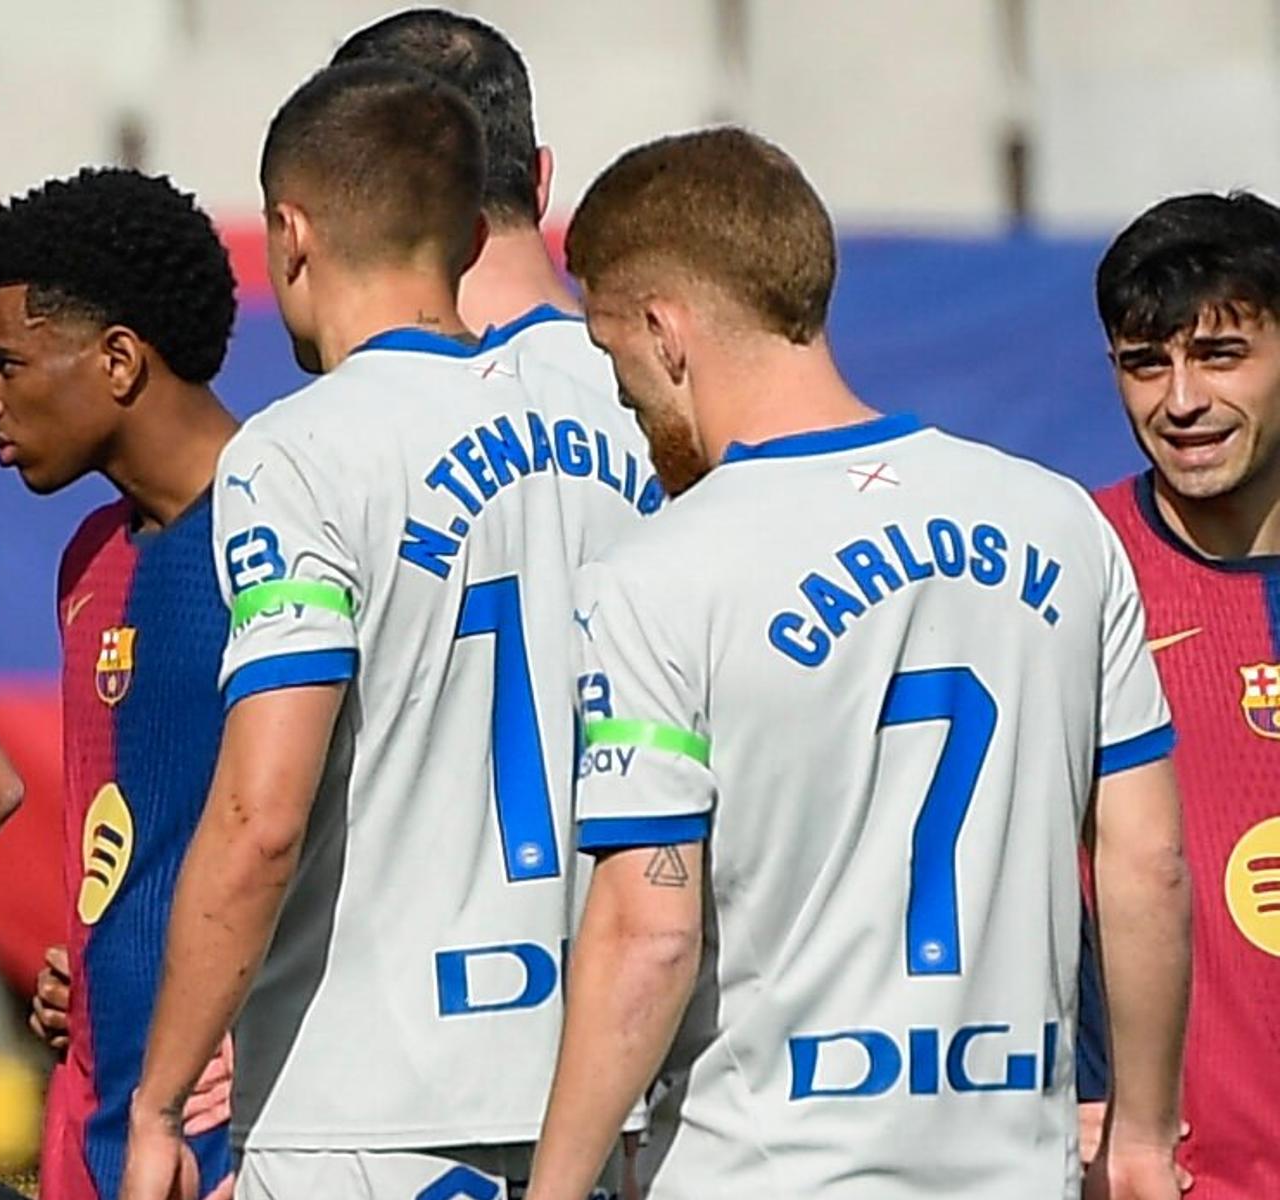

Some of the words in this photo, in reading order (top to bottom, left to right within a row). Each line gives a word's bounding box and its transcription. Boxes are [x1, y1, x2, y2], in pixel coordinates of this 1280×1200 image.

[769, 519, 1007, 667] CARLOS
[1019, 544, 1066, 627] V.
[878, 667, 998, 976] 7
